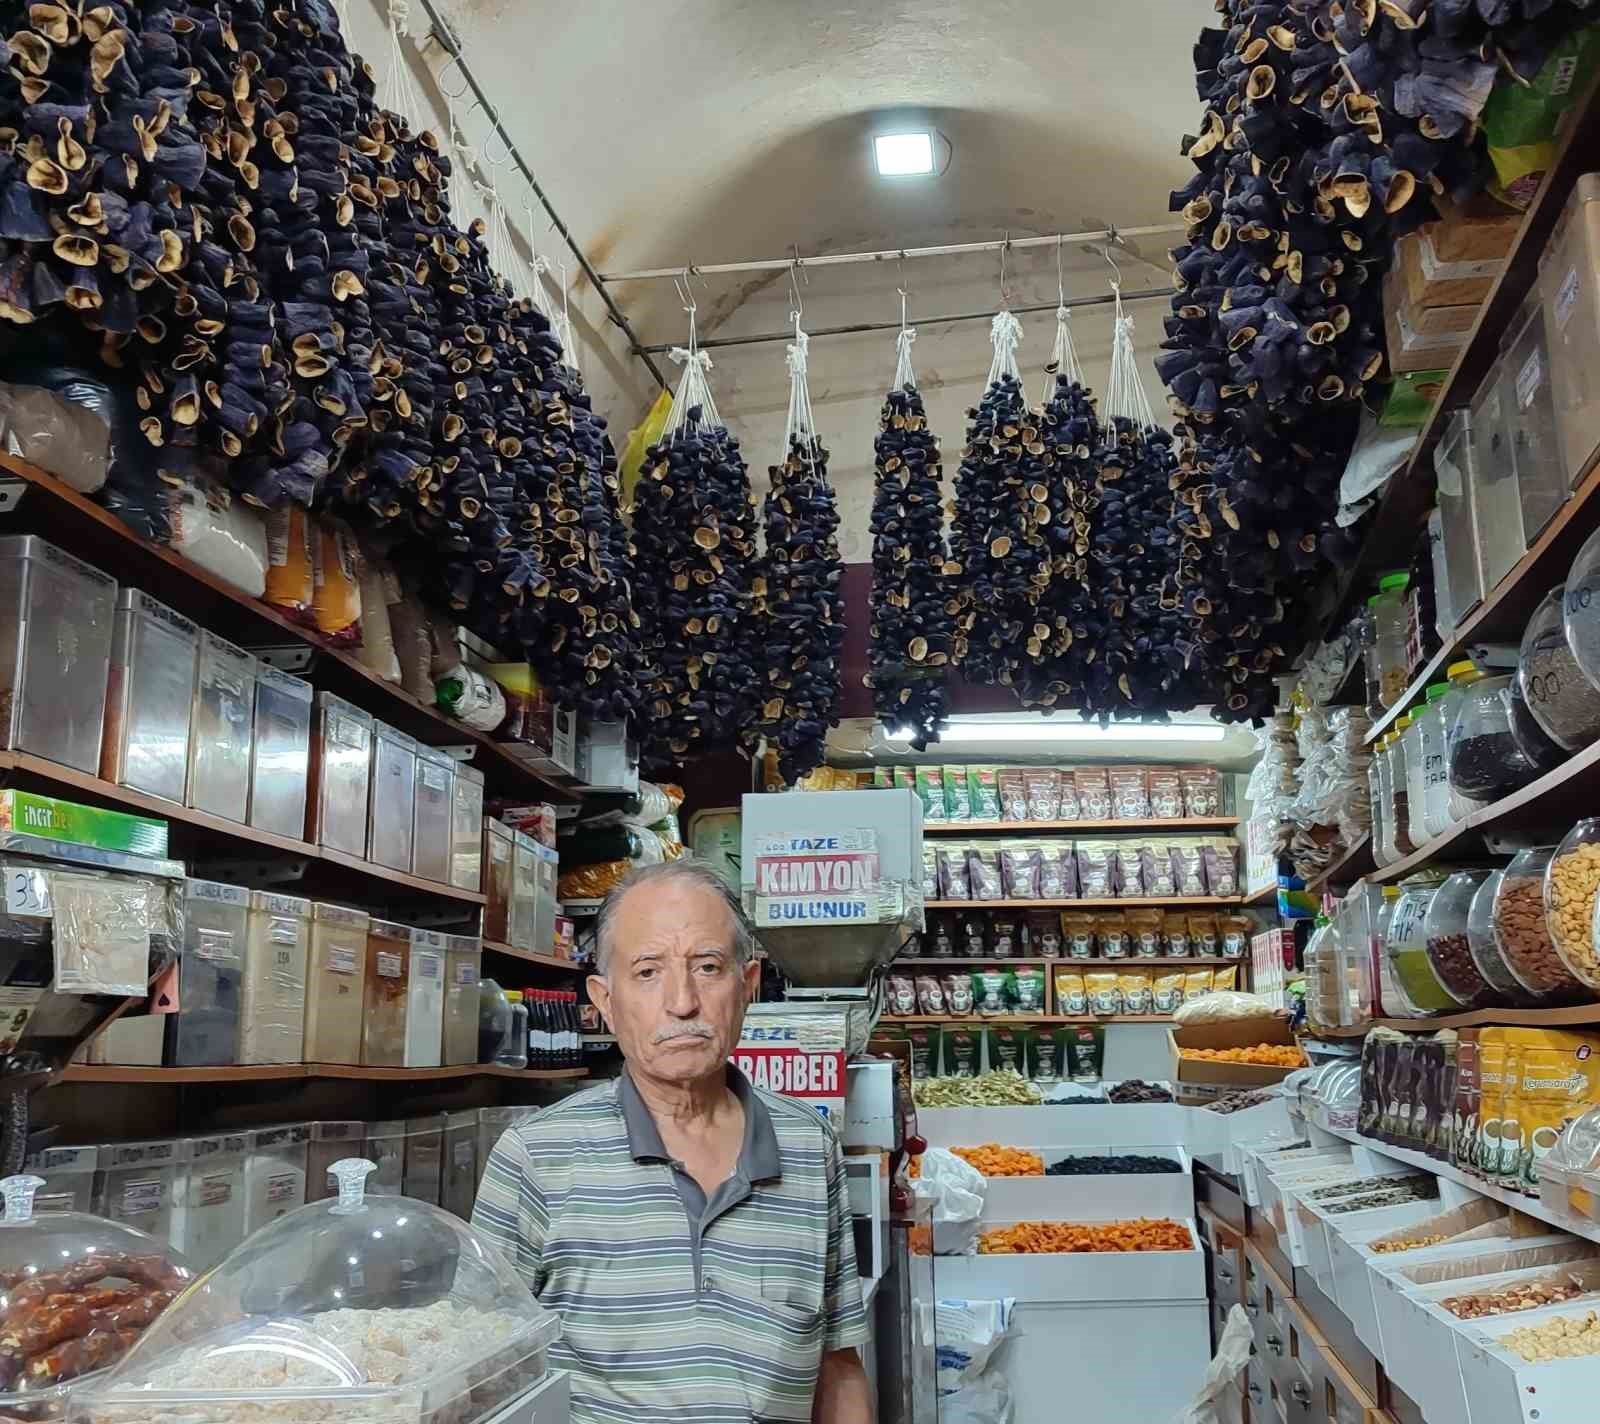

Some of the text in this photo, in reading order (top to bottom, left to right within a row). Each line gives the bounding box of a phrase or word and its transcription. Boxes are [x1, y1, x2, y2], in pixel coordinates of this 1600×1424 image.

[791, 838, 839, 850] TAZE
[768, 901, 867, 920] BULUNUR
[728, 1055, 838, 1091] RABiBER
